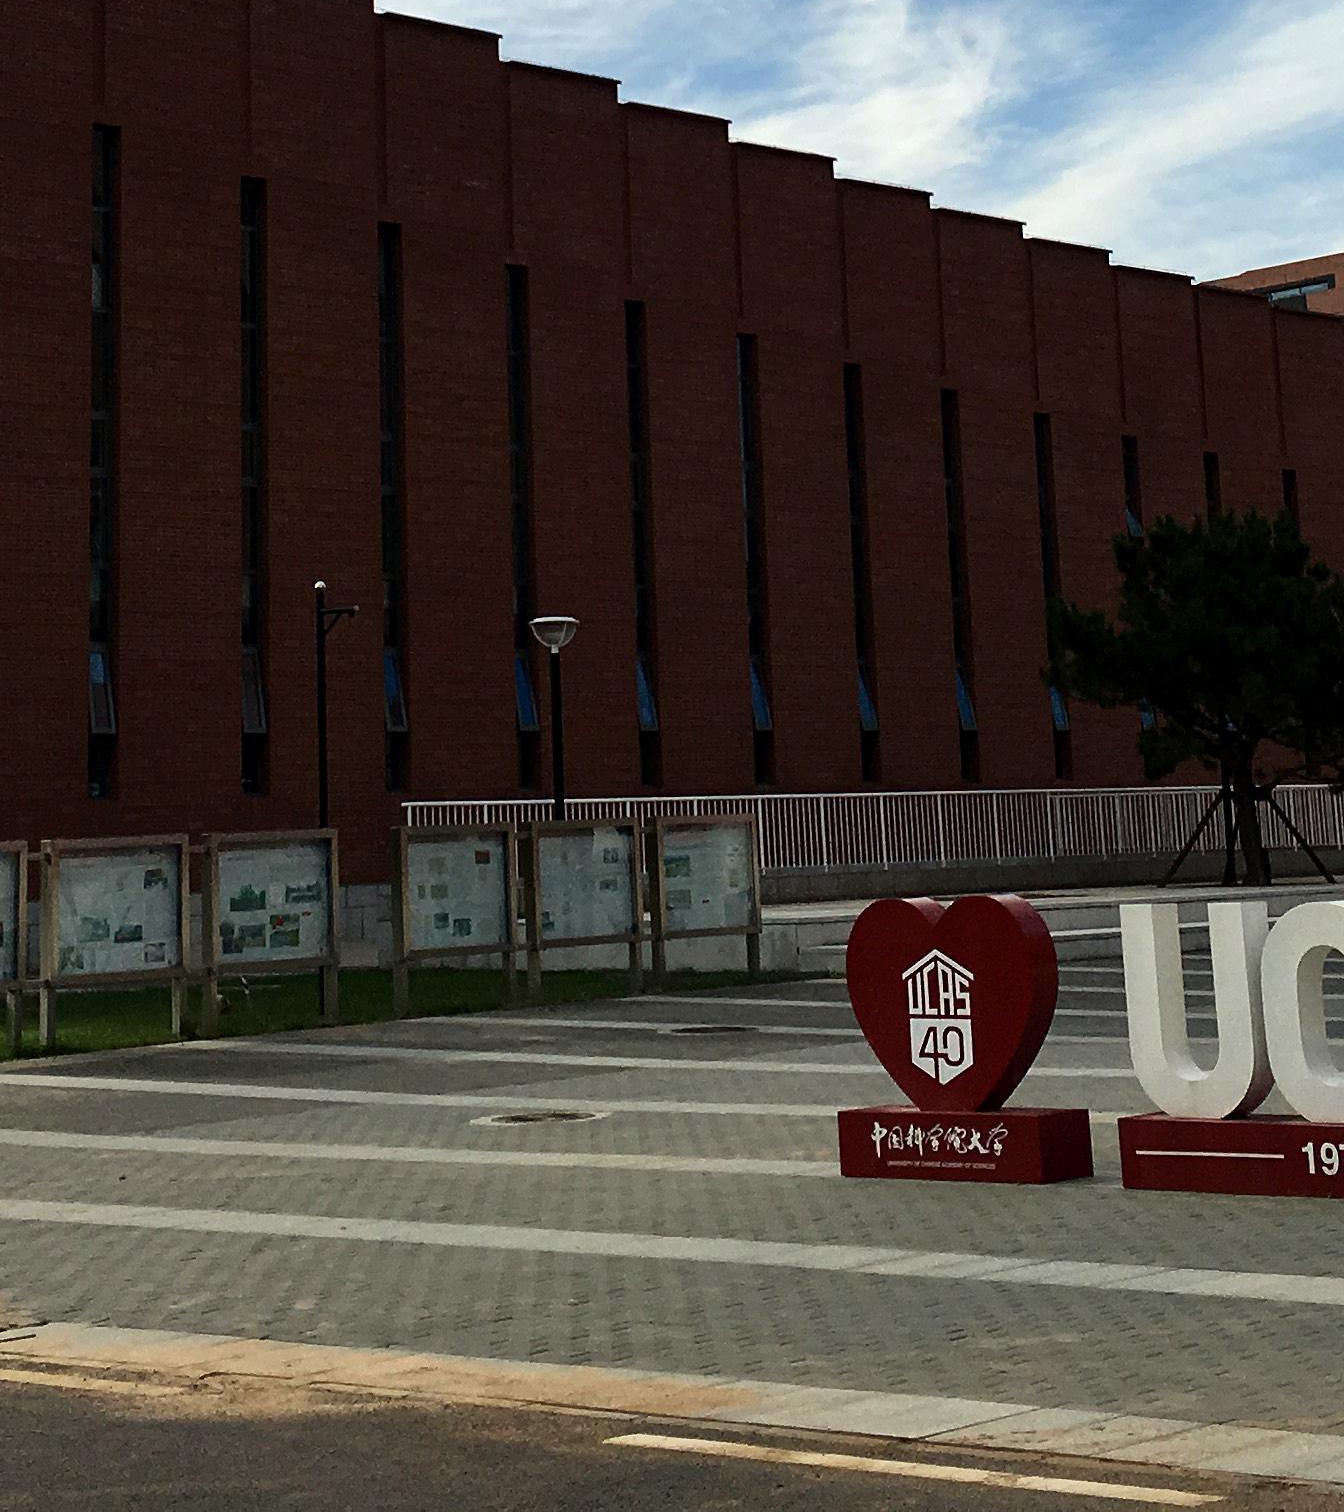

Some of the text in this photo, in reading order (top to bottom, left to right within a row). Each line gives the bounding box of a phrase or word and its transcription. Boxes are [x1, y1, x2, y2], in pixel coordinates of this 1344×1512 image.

[907, 960, 971, 1016] UCAS
[918, 1026, 965, 1078] 40
[870, 1121, 1009, 1159] 中国科学院大学
